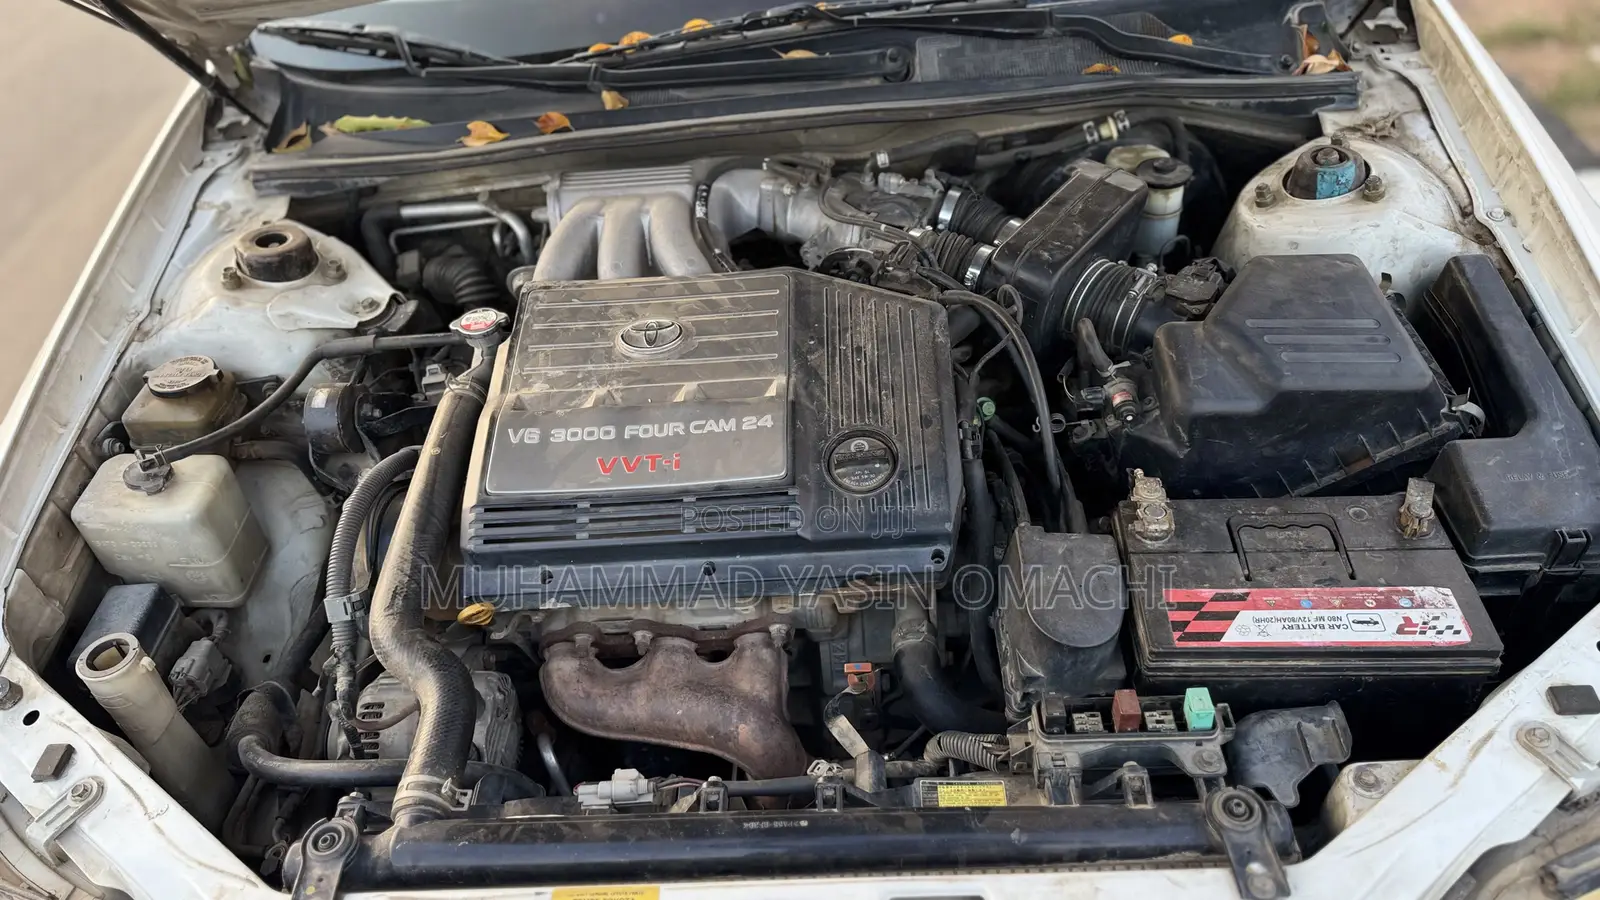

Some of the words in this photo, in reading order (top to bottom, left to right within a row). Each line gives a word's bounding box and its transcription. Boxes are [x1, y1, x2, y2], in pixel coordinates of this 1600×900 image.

[508, 428, 541, 444] V6
[550, 425, 616, 443] 3000
[624, 421, 685, 439] FOUR
[689, 418, 737, 435] CAM
[742, 414, 774, 431] 24
[596, 452, 681, 476] VVT-i
